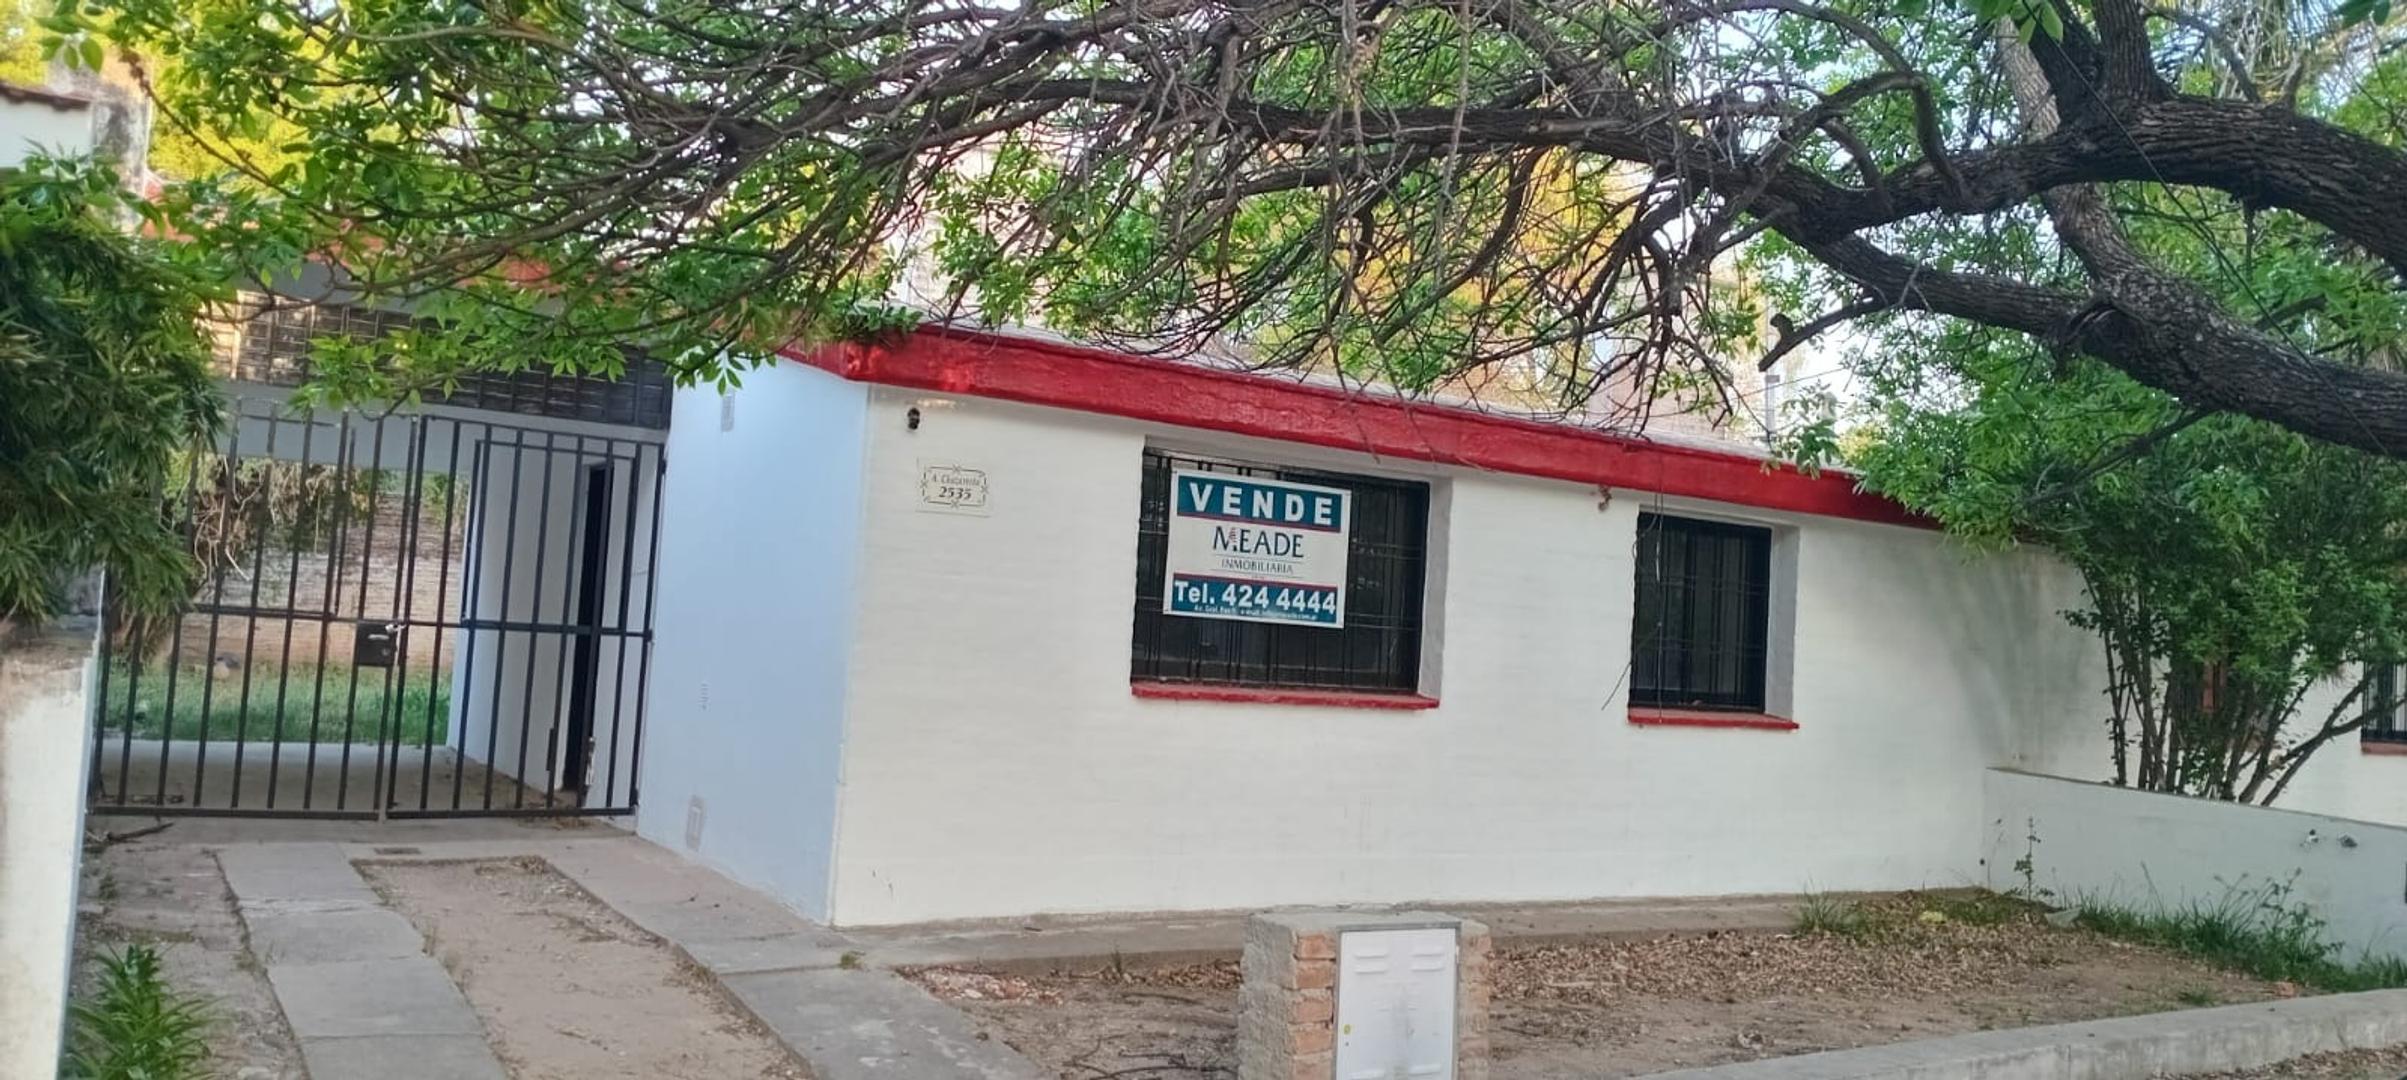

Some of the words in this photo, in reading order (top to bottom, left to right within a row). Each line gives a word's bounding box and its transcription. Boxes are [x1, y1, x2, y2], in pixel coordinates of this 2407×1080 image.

[939, 486, 972, 500] 2535
[1189, 482, 1333, 525] VENDE
[1212, 525, 1304, 558] MEADE
[1221, 559, 1294, 574] INMOBILIARIA
[1174, 580, 1215, 605] Tel.
[1222, 583, 1270, 609] 424
[1276, 588, 1336, 614] 4444
